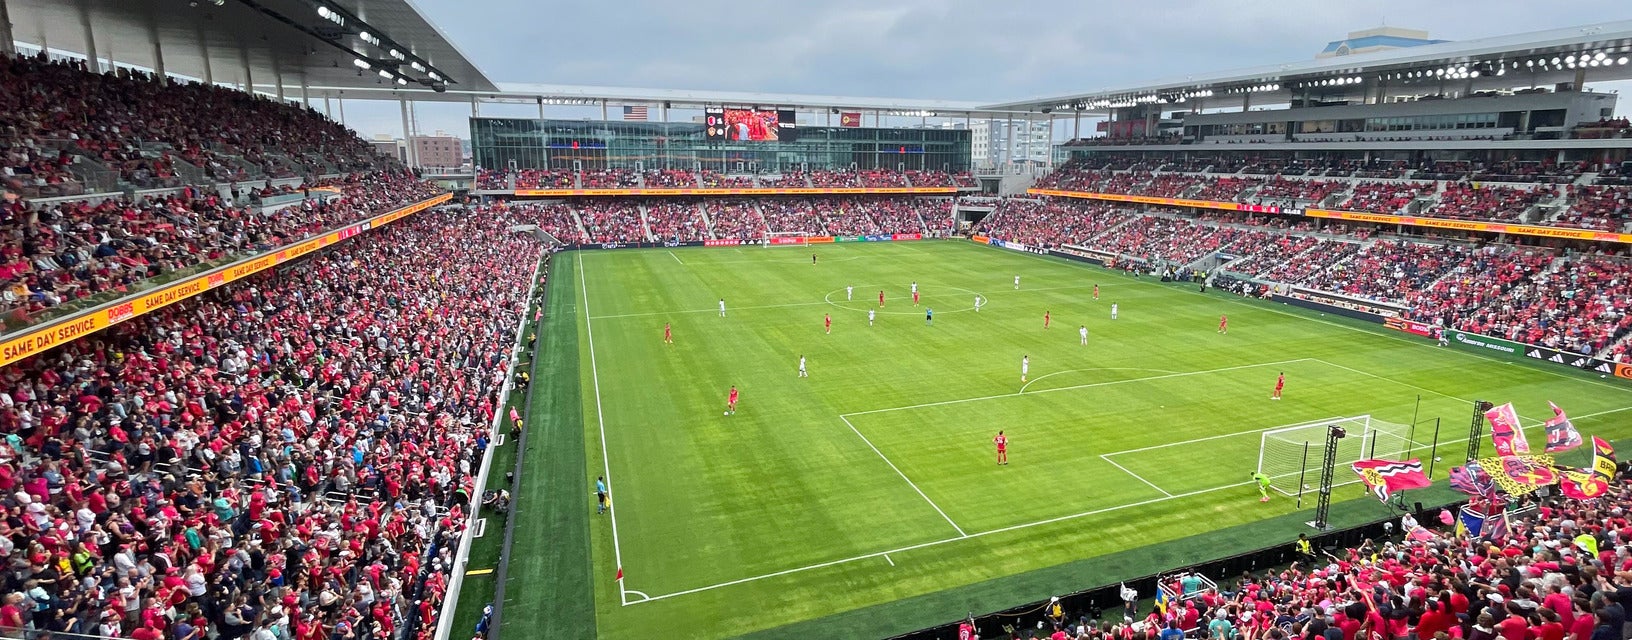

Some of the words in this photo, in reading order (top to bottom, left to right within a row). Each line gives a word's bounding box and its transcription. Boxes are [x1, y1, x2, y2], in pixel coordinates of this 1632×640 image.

[145, 295, 164, 309] SAME
[165, 290, 177, 303] DAY
[178, 282, 201, 297] SERVICE
[108, 302, 134, 319] DOBBS
[4, 340, 34, 361] SAME
[37, 332, 57, 349] DAY
[59, 318, 96, 340] SERVICE
